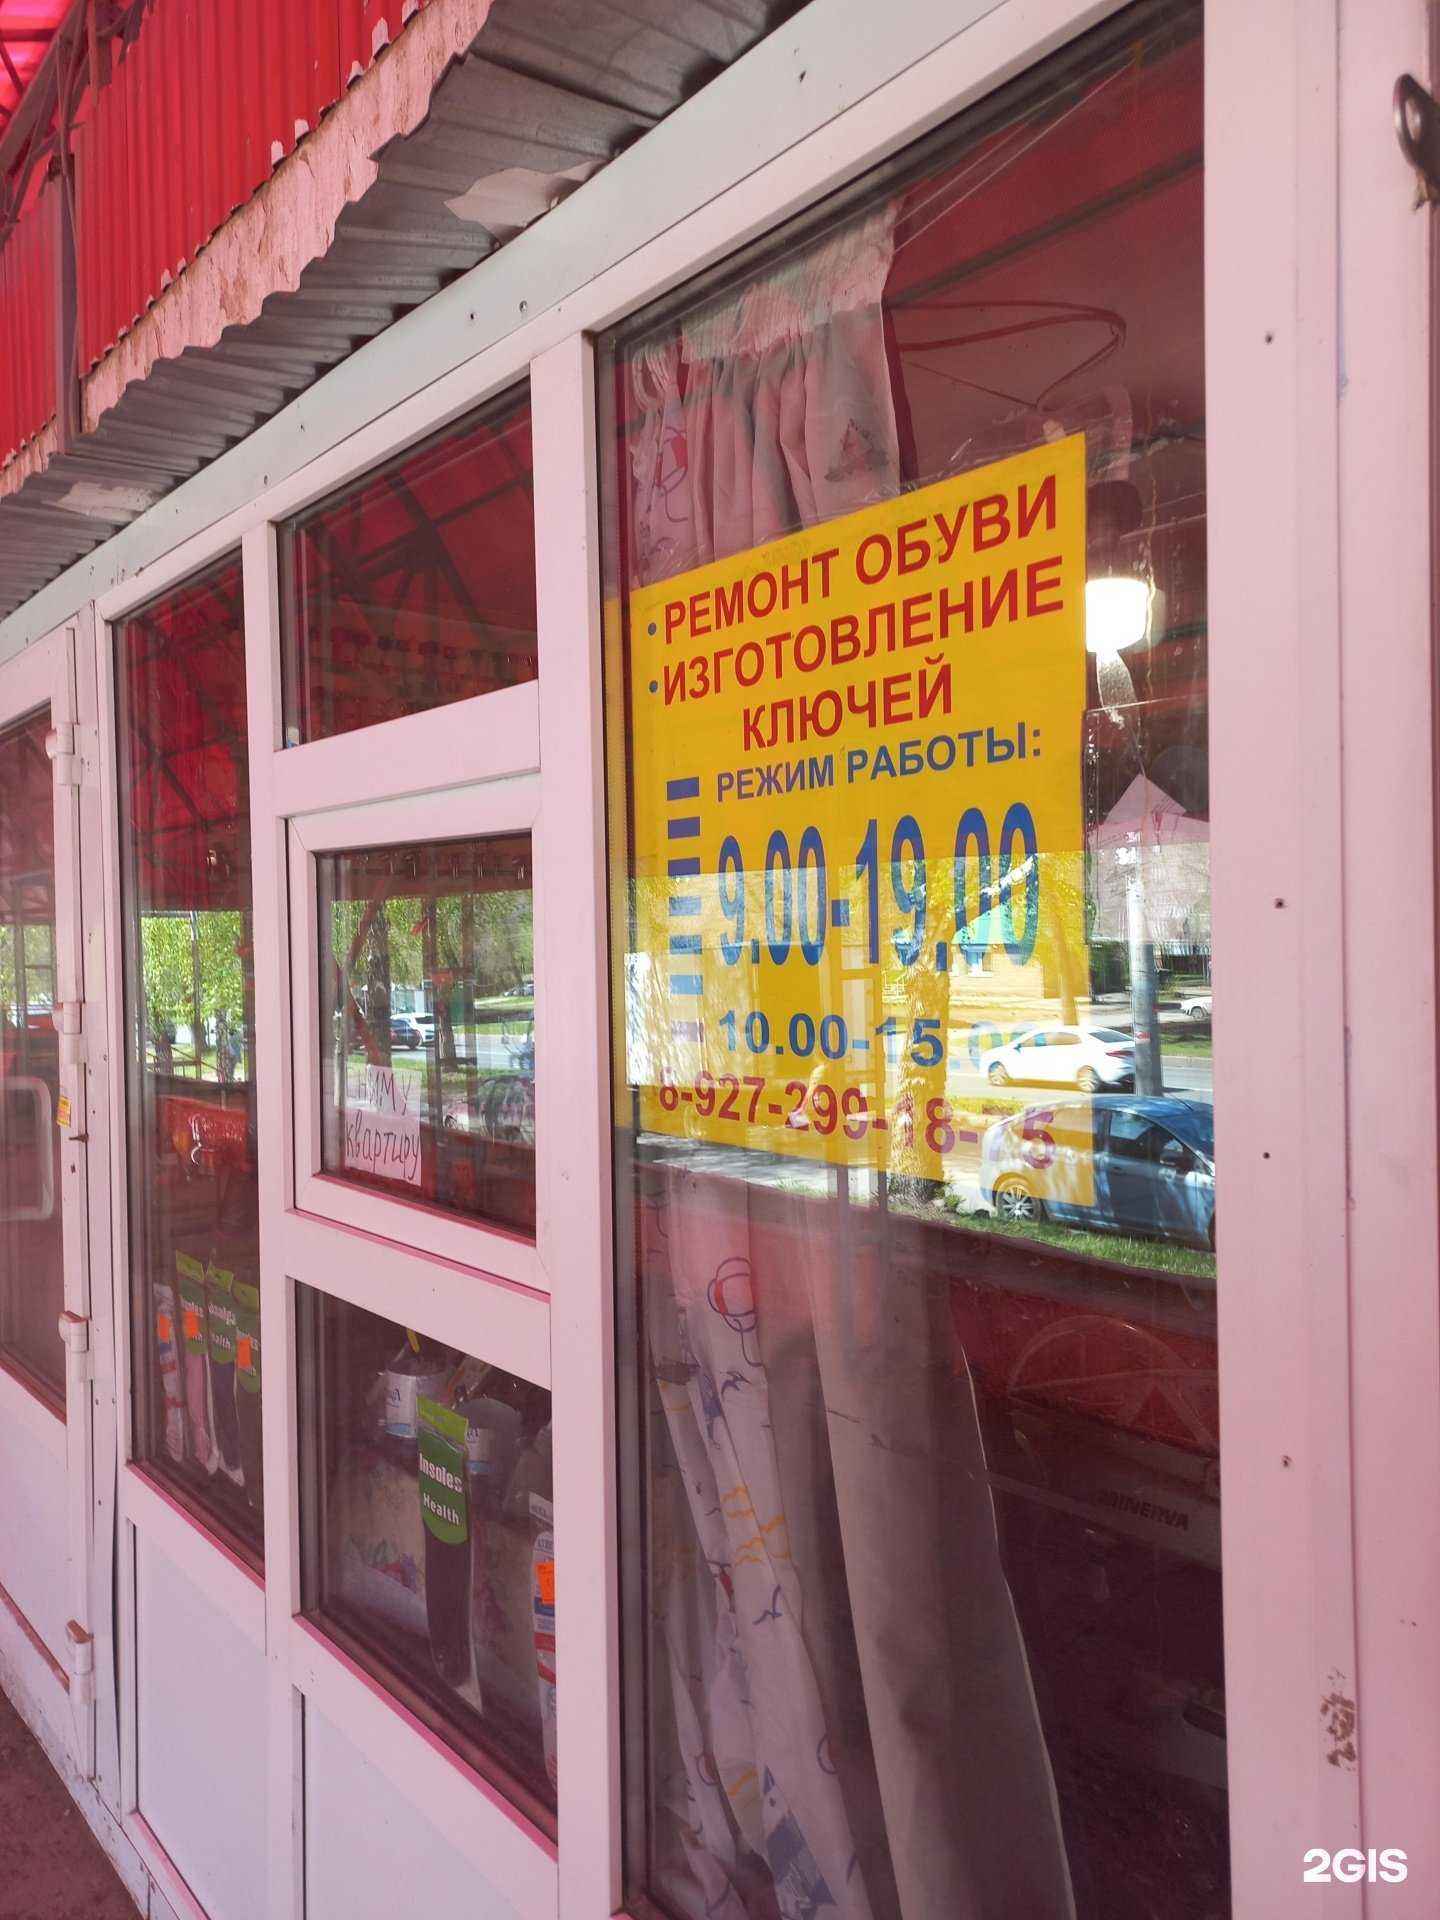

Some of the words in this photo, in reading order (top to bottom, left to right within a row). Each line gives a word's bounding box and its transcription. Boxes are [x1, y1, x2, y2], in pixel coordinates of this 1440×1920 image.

[665, 548, 839, 645] РЕМОНТ
[855, 474, 1057, 586] ОБУВИ
[663, 556, 1064, 706] ИЗГОТОВЛЕНИЕ
[743, 652, 953, 752] КЛЮЧЕЙ
[716, 754, 834, 803] РЕЖИМ
[847, 721, 1042, 784] РАБОТЫ:
[717, 802, 1040, 967] 9.00-19.00
[418, 1452, 464, 1494] Insoles
[423, 1492, 461, 1527] Health
